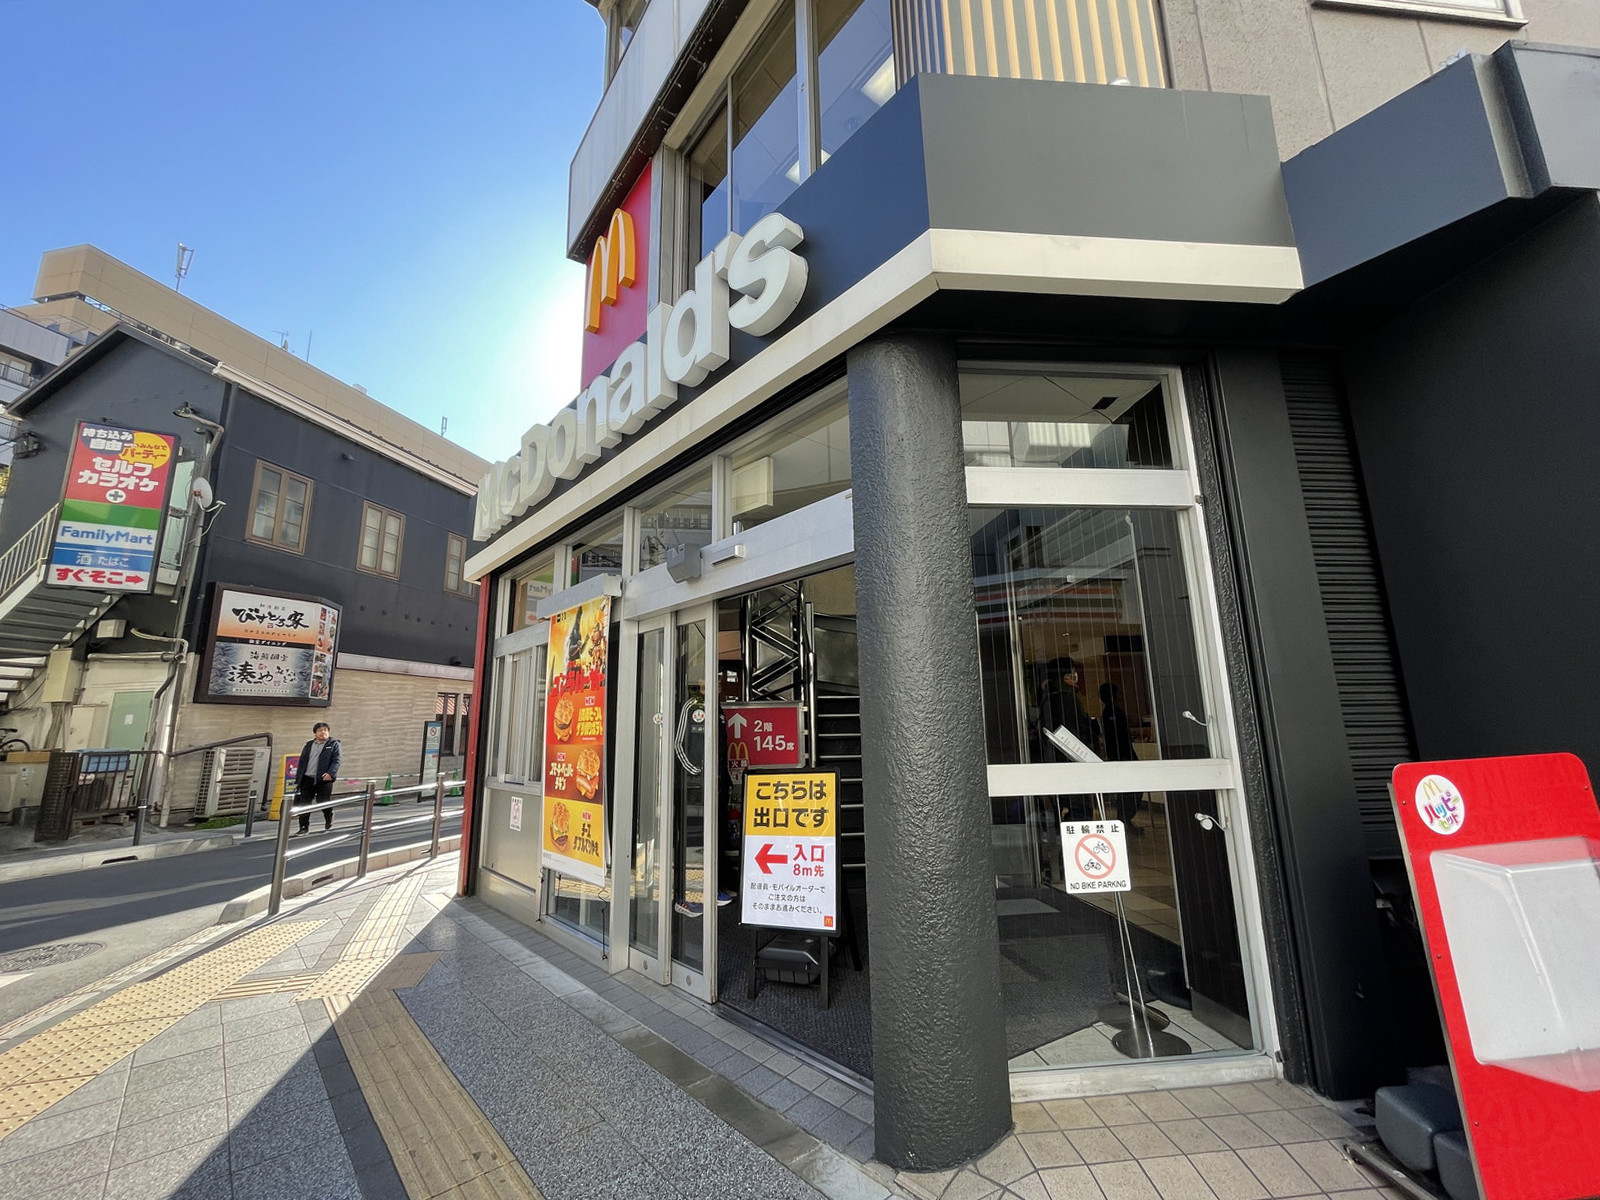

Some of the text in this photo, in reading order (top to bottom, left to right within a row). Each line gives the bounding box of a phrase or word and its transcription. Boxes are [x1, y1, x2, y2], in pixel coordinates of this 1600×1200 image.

[473, 212, 808, 542] McDonald's
[82, 427, 133, 441] 持ち込み
[89, 438, 122, 451] 自由
[93, 457, 153, 477] セルフ
[77, 469, 159, 492] カラオケ
[60, 526, 153, 545] FamilyMart
[76, 552, 94, 566] 酒
[56, 567, 124, 585] すぐそこ
[754, 720, 773, 733] 2階
[753, 735, 795, 752] 145席
[756, 780, 827, 801] こちらは
[1424, 791, 1460, 824] ハッピー
[753, 807, 829, 828] 出口です
[1066, 824, 1119, 834] 駐輪禁止
[793, 844, 825, 862] 入口
[793, 864, 825, 877] 8m先
[1070, 882, 1080, 890] NO
[1097, 880, 1127, 888] PARKING
[768, 893, 806, 902] ご注文の方は
[752, 902, 822, 914] そのままお進みください。
